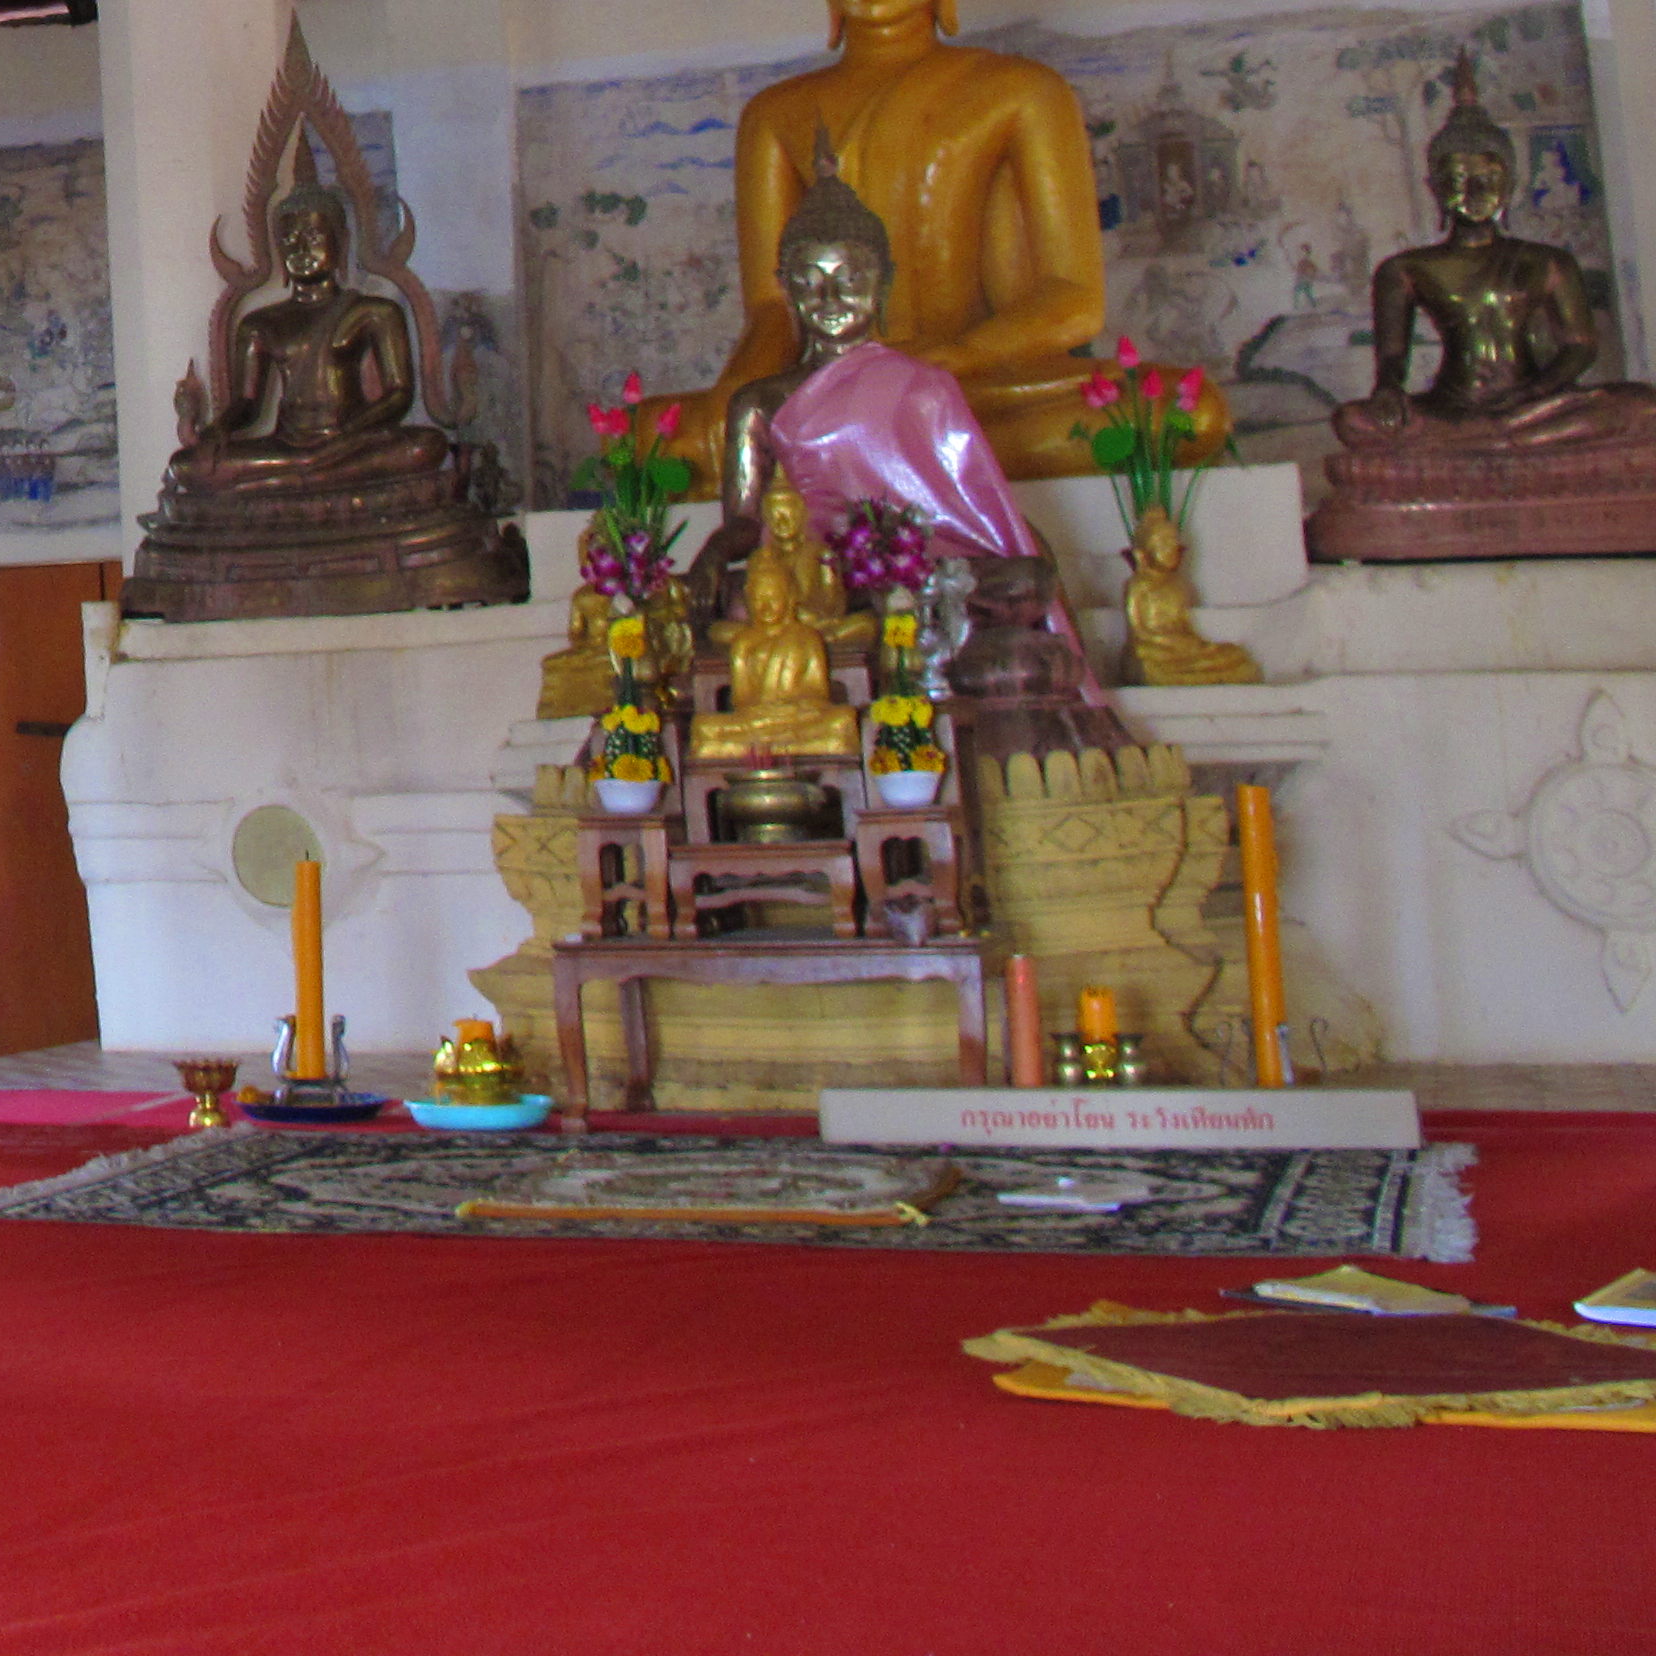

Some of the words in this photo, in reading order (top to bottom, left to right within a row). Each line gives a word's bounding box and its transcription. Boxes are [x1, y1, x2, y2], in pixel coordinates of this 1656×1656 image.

[959, 1097, 1117, 1135] กรุณาอย่าโยน
